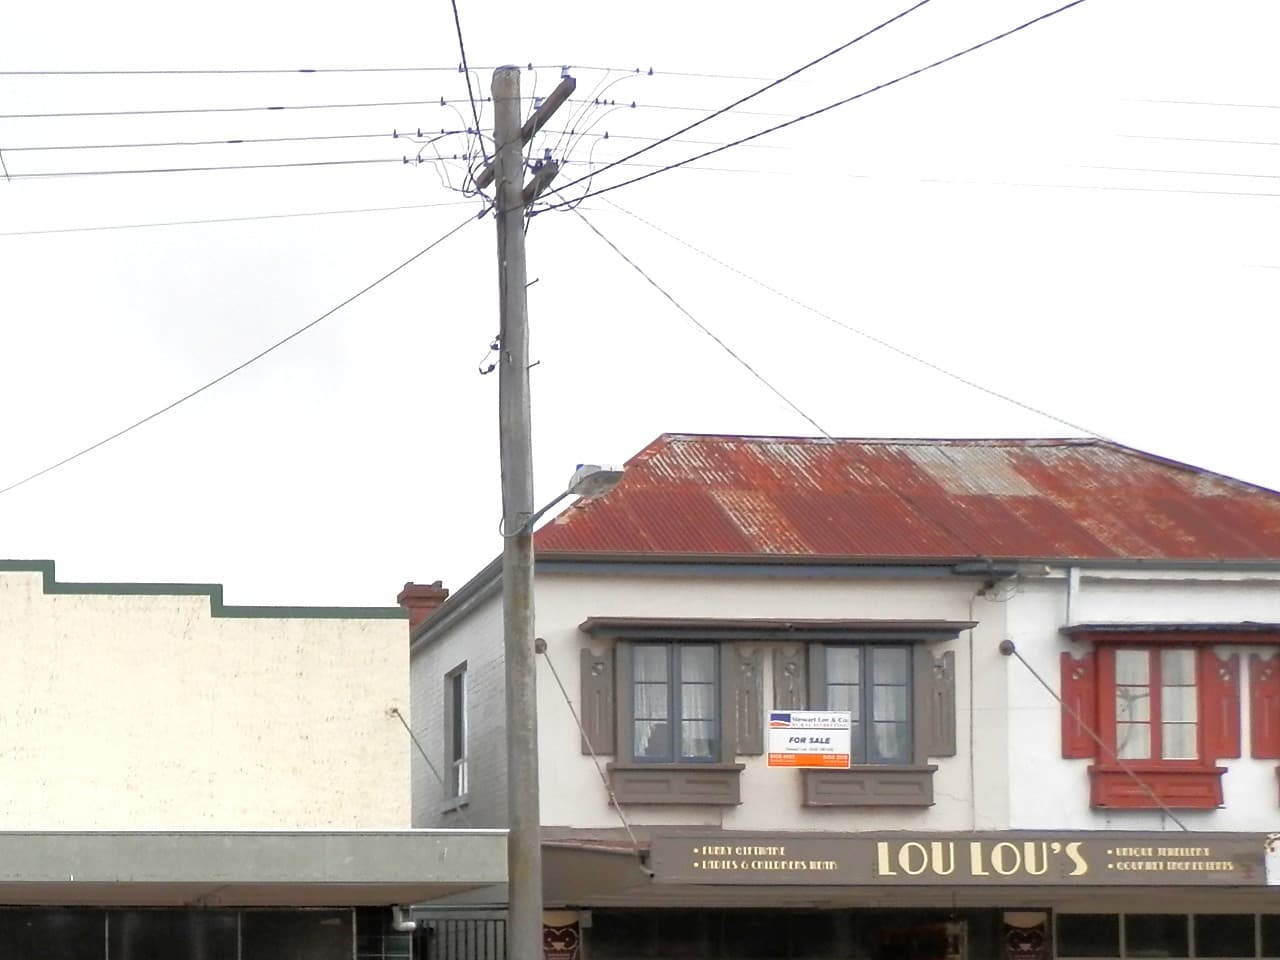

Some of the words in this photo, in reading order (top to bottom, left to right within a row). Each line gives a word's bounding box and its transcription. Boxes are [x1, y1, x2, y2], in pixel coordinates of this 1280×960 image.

[789, 736, 807, 744] FOR
[809, 737, 831, 745] SALE
[877, 841, 955, 876] LOU
[969, 841, 1088, 876] LOU'S
[702, 860, 738, 870] LADIES
[741, 860, 749, 870] &
